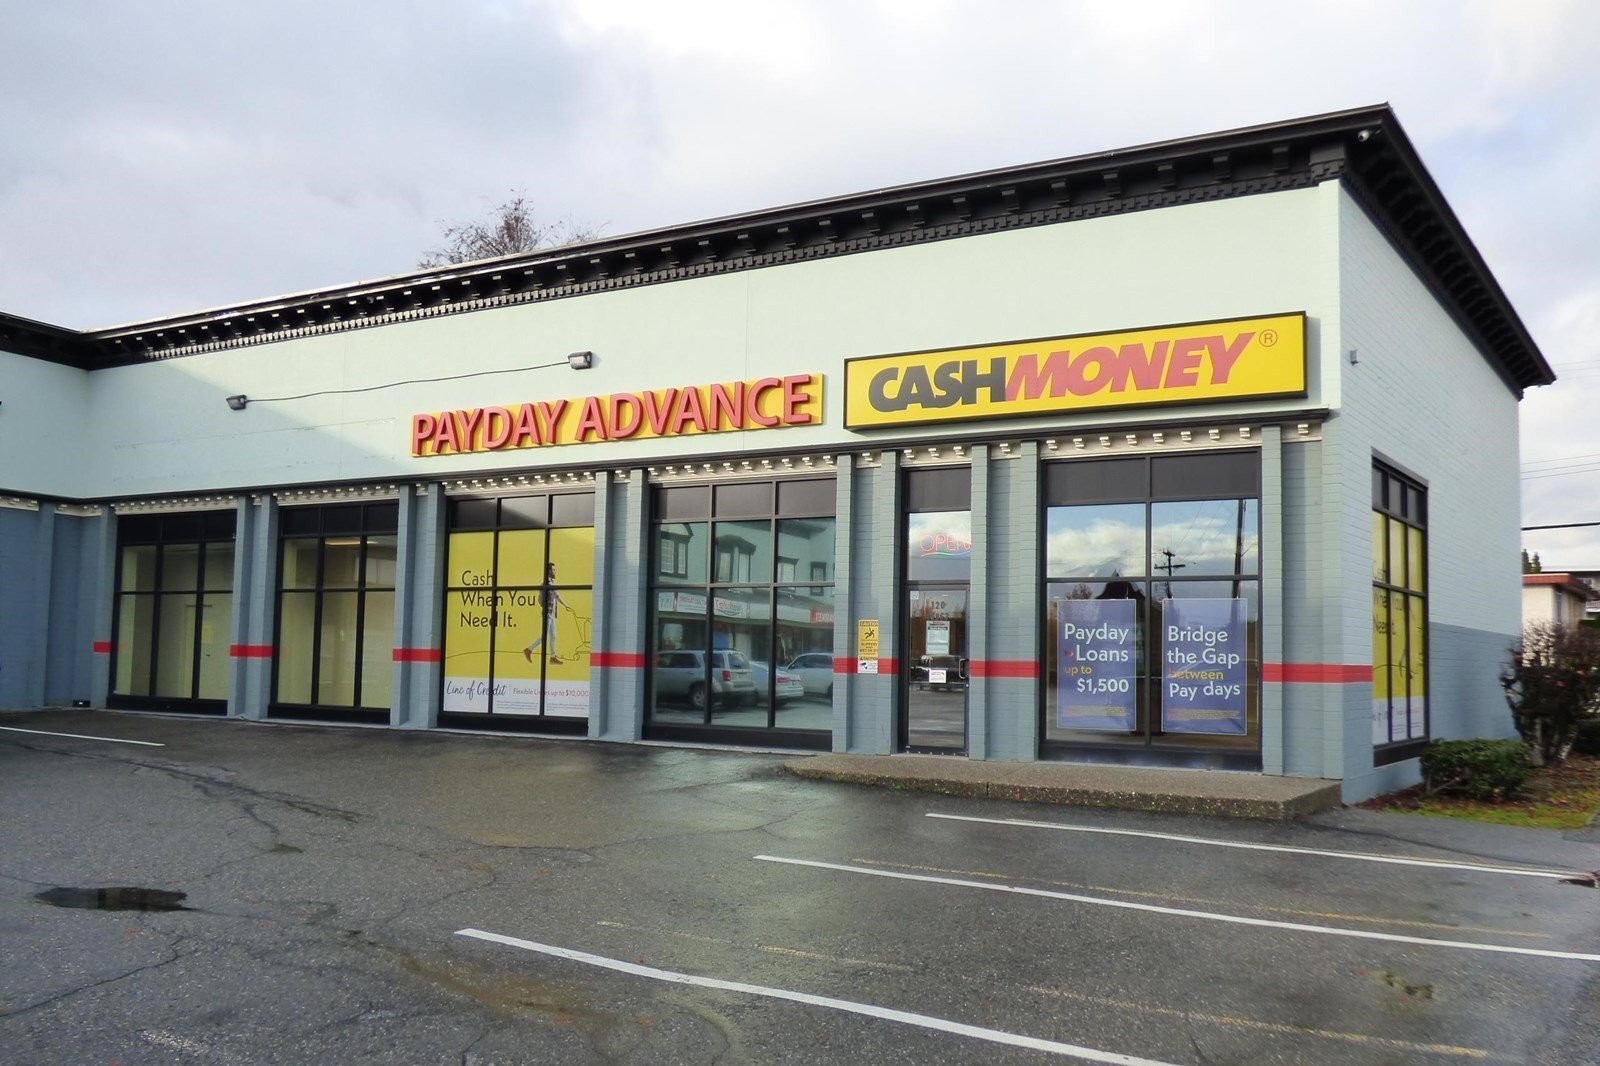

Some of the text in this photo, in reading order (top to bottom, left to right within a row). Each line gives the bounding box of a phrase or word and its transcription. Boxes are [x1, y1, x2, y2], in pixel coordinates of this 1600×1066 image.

[412, 374, 811, 455] PAYDAY ADVANCE
[920, 533, 972, 552] OPEN
[461, 569, 494, 587] Cash
[461, 590, 536, 607] When You
[503, 611, 517, 628] It.
[1064, 622, 1129, 644] Payday
[1168, 625, 1228, 647] Bridge
[1076, 644, 1129, 662] Loans
[1167, 647, 1240, 669] the Gap
[1064, 665, 1092, 676] up to
[1168, 667, 1224, 680] between
[466, 680, 475, 700] of
[534, 688, 550, 696] Lies
[1077, 678, 1129, 695] $1,500
[1169, 680, 1241, 701] Pay days
